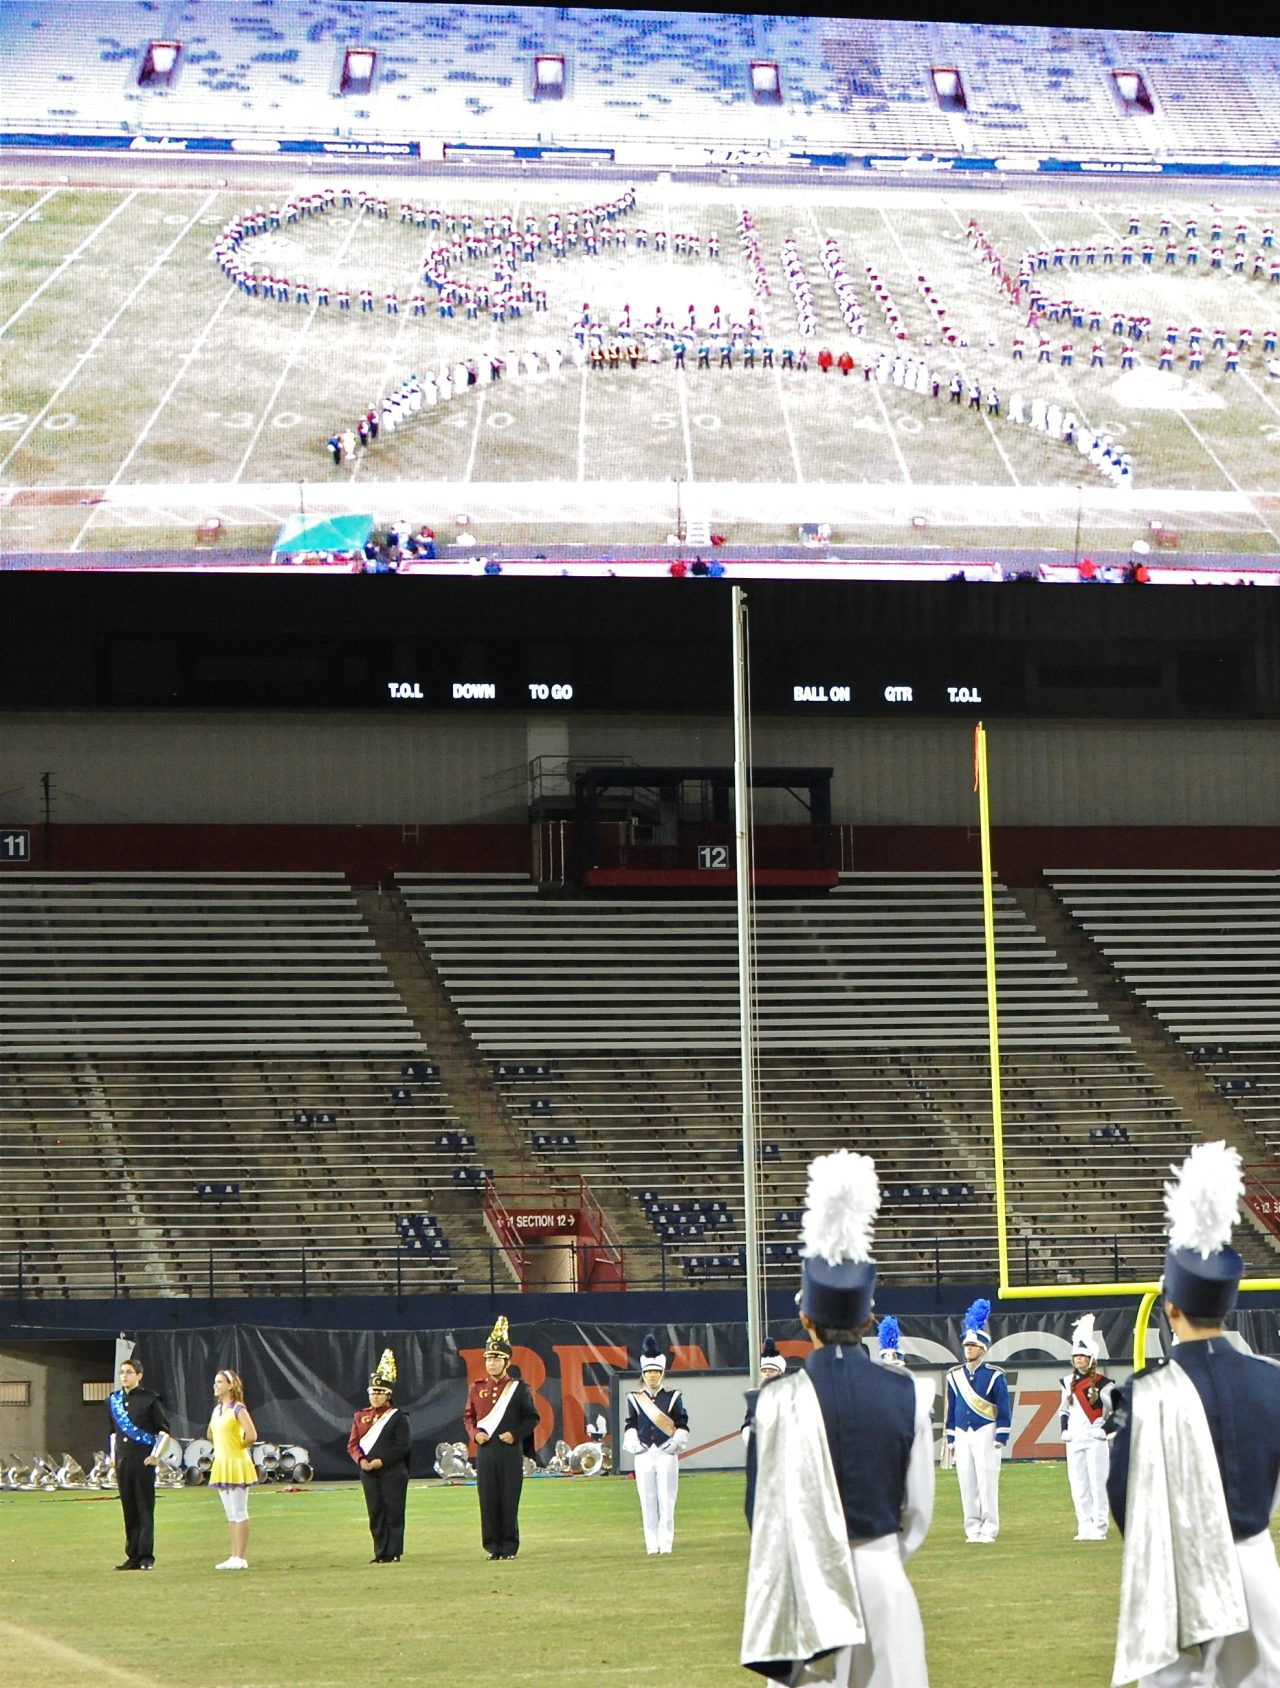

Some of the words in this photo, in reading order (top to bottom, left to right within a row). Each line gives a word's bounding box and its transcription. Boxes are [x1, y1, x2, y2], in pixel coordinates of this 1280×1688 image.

[452, 684, 496, 699] DOWN
[528, 685, 549, 699] TO
[551, 685, 574, 700] GO
[793, 686, 828, 701] BALL
[829, 687, 850, 701] ON
[884, 687, 913, 702] QTR
[3, 835, 25, 856] 11
[700, 847, 727, 868] 12
[516, 1215, 554, 1227] SECTION
[556, 1215, 567, 1227] 12
